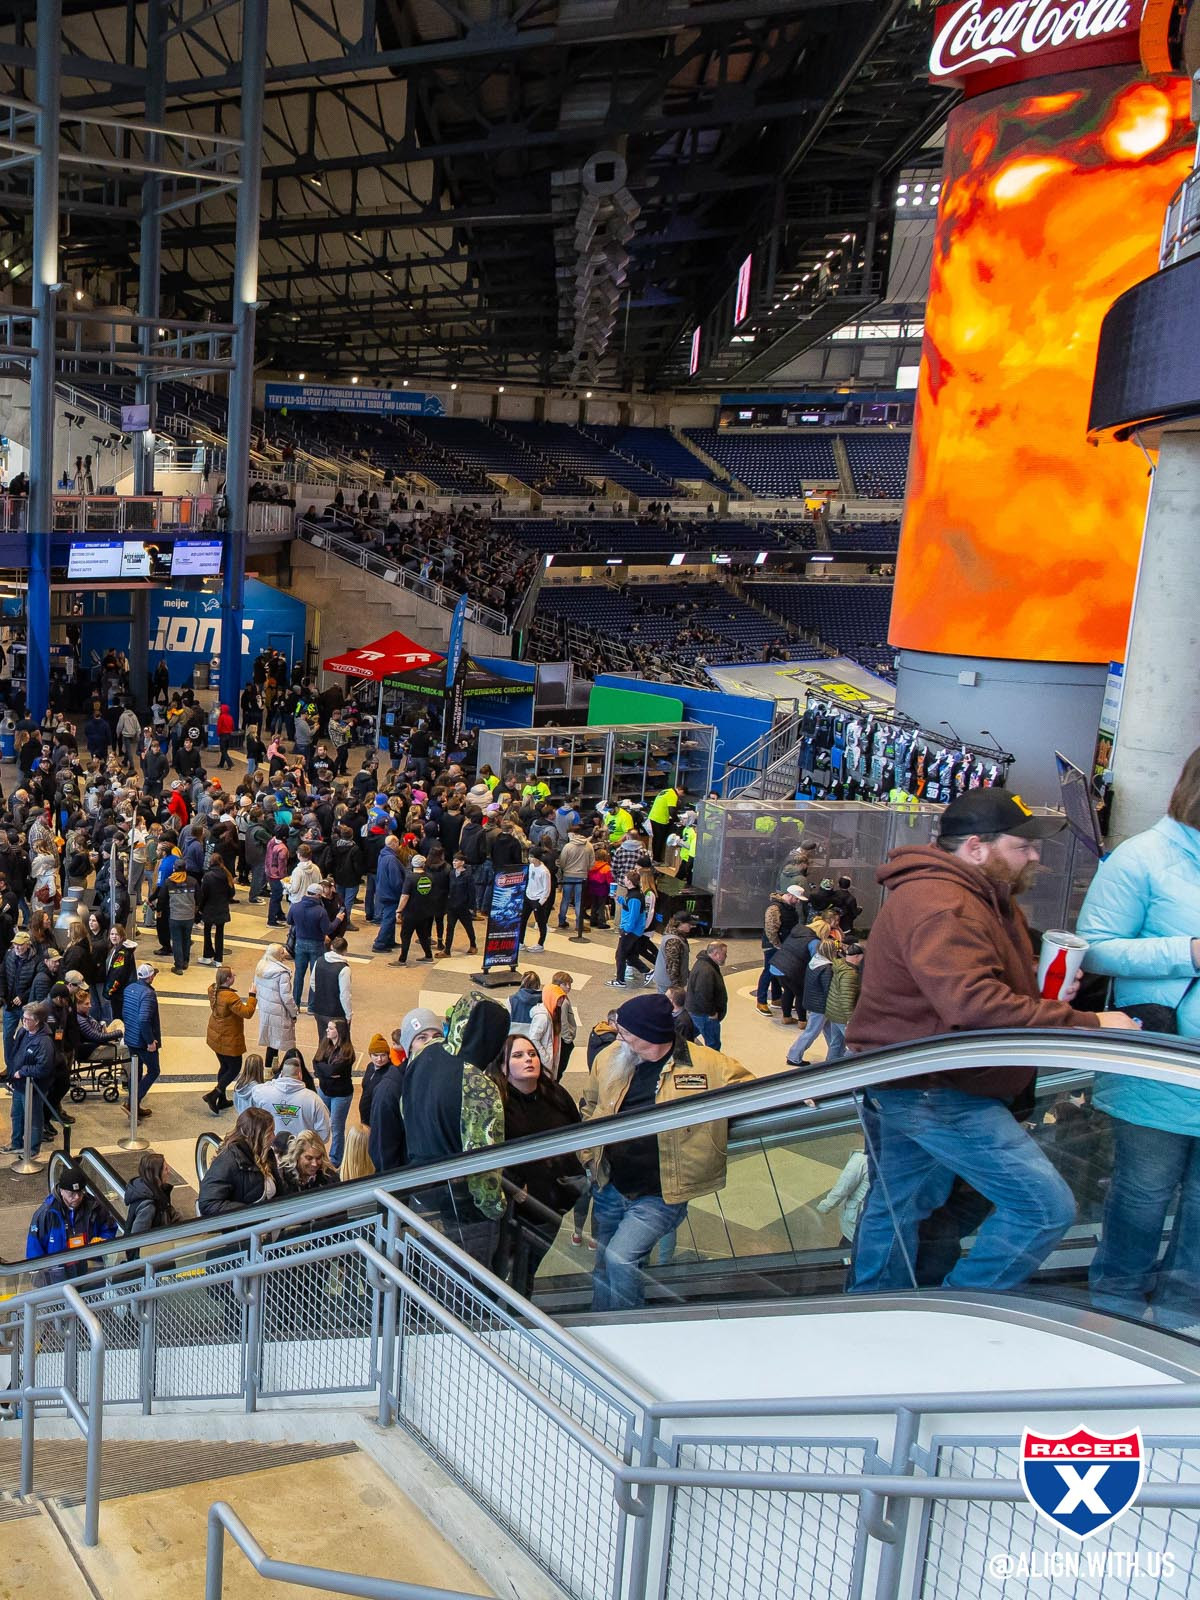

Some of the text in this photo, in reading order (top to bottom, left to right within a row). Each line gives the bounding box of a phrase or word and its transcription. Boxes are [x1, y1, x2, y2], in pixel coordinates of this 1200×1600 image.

[303, 387, 323, 397] REPORT
[269, 395, 282, 404] TEXT
[340, 399, 356, 408] WITH
[356, 400, 366, 408] THE
[396, 402, 422, 411] LOCATION
[163, 598, 190, 609] meijer
[392, 681, 420, 694] EXPERIENCE
[420, 685, 444, 697] CHECK-IN
[503, 685, 534, 694] CHECK-IN
